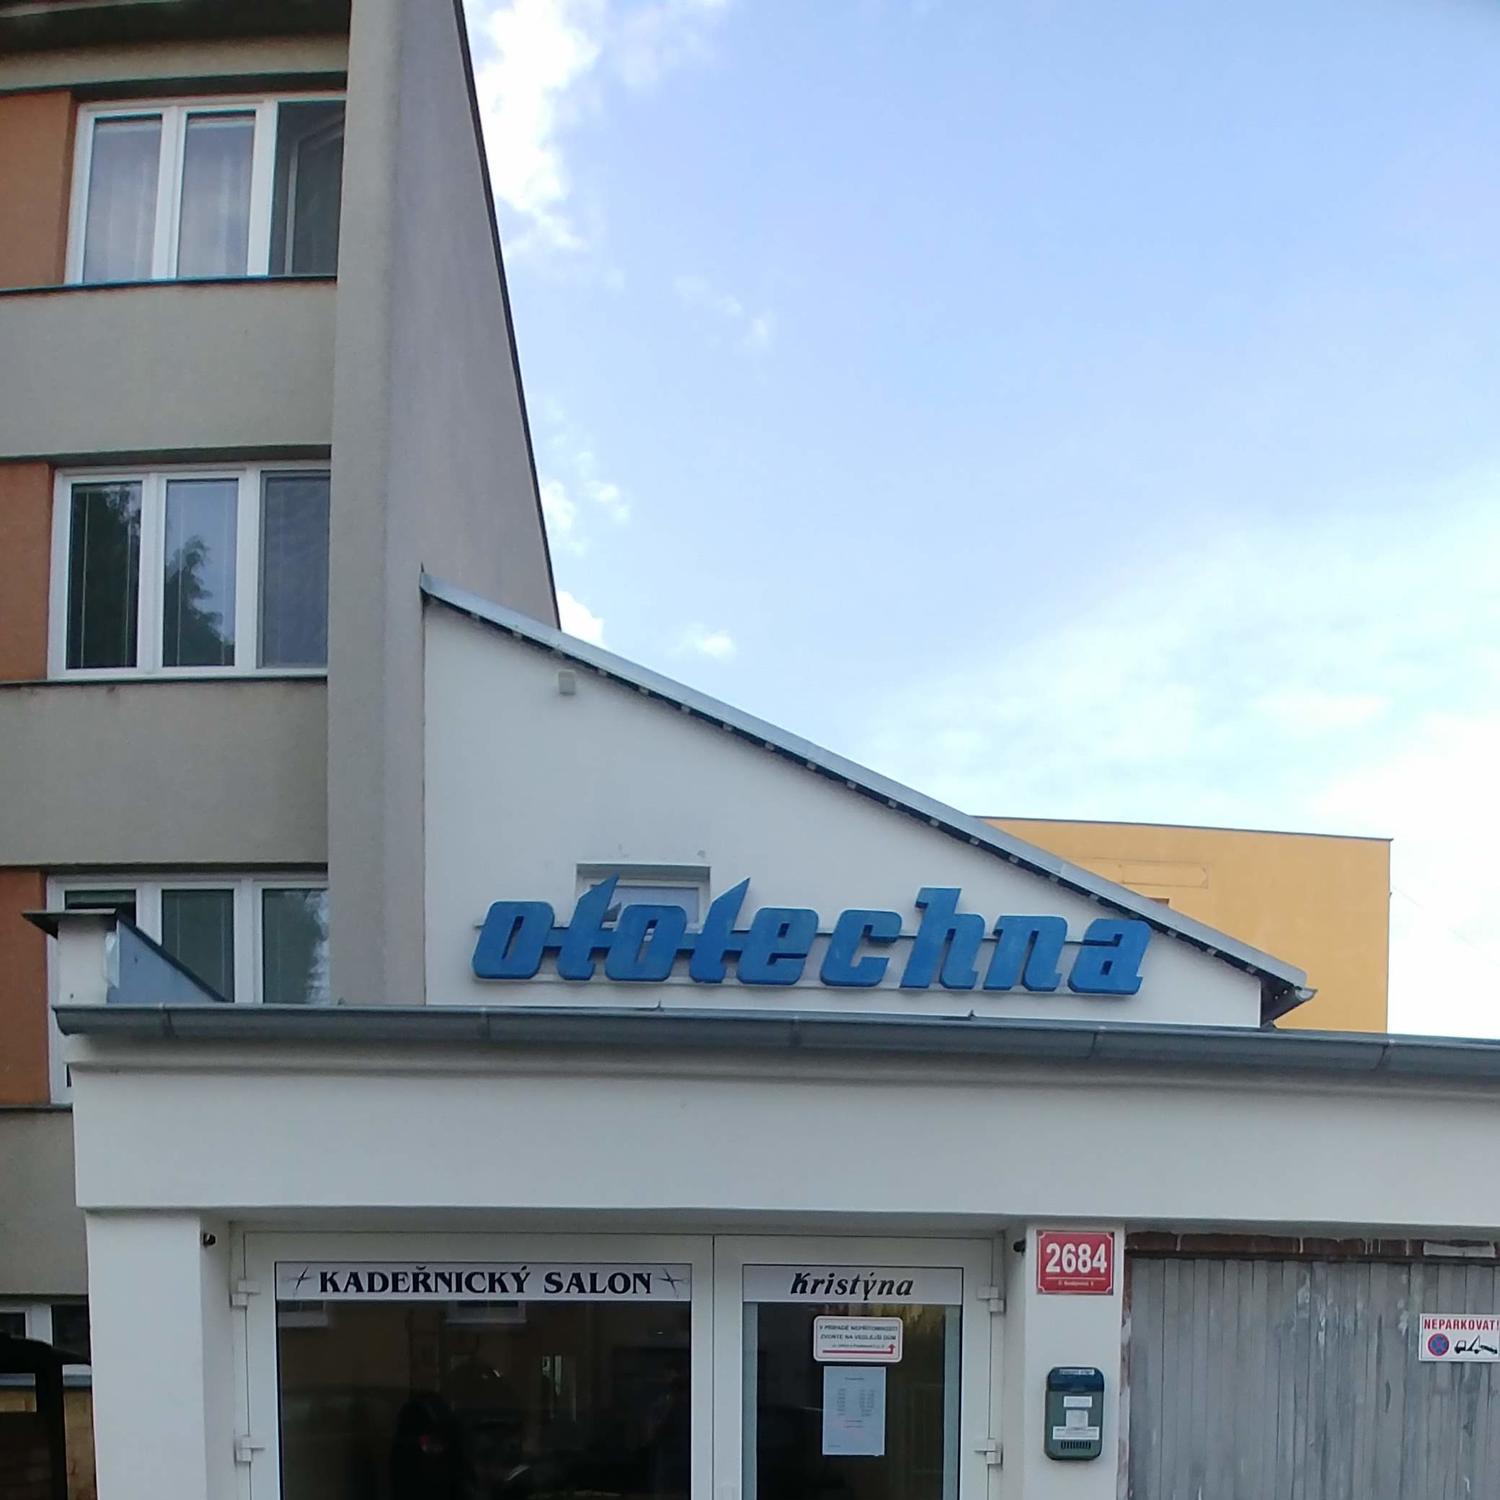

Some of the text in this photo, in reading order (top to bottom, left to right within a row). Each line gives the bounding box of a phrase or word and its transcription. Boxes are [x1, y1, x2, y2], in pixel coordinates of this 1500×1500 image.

[1045, 1242, 1108, 1274] 2684
[319, 1265, 653, 1295] KADEŘNICKÝ SALON
[790, 1272, 914, 1301] Kristýna
[1423, 1318, 1500, 1331] NEPARKOVAT!
